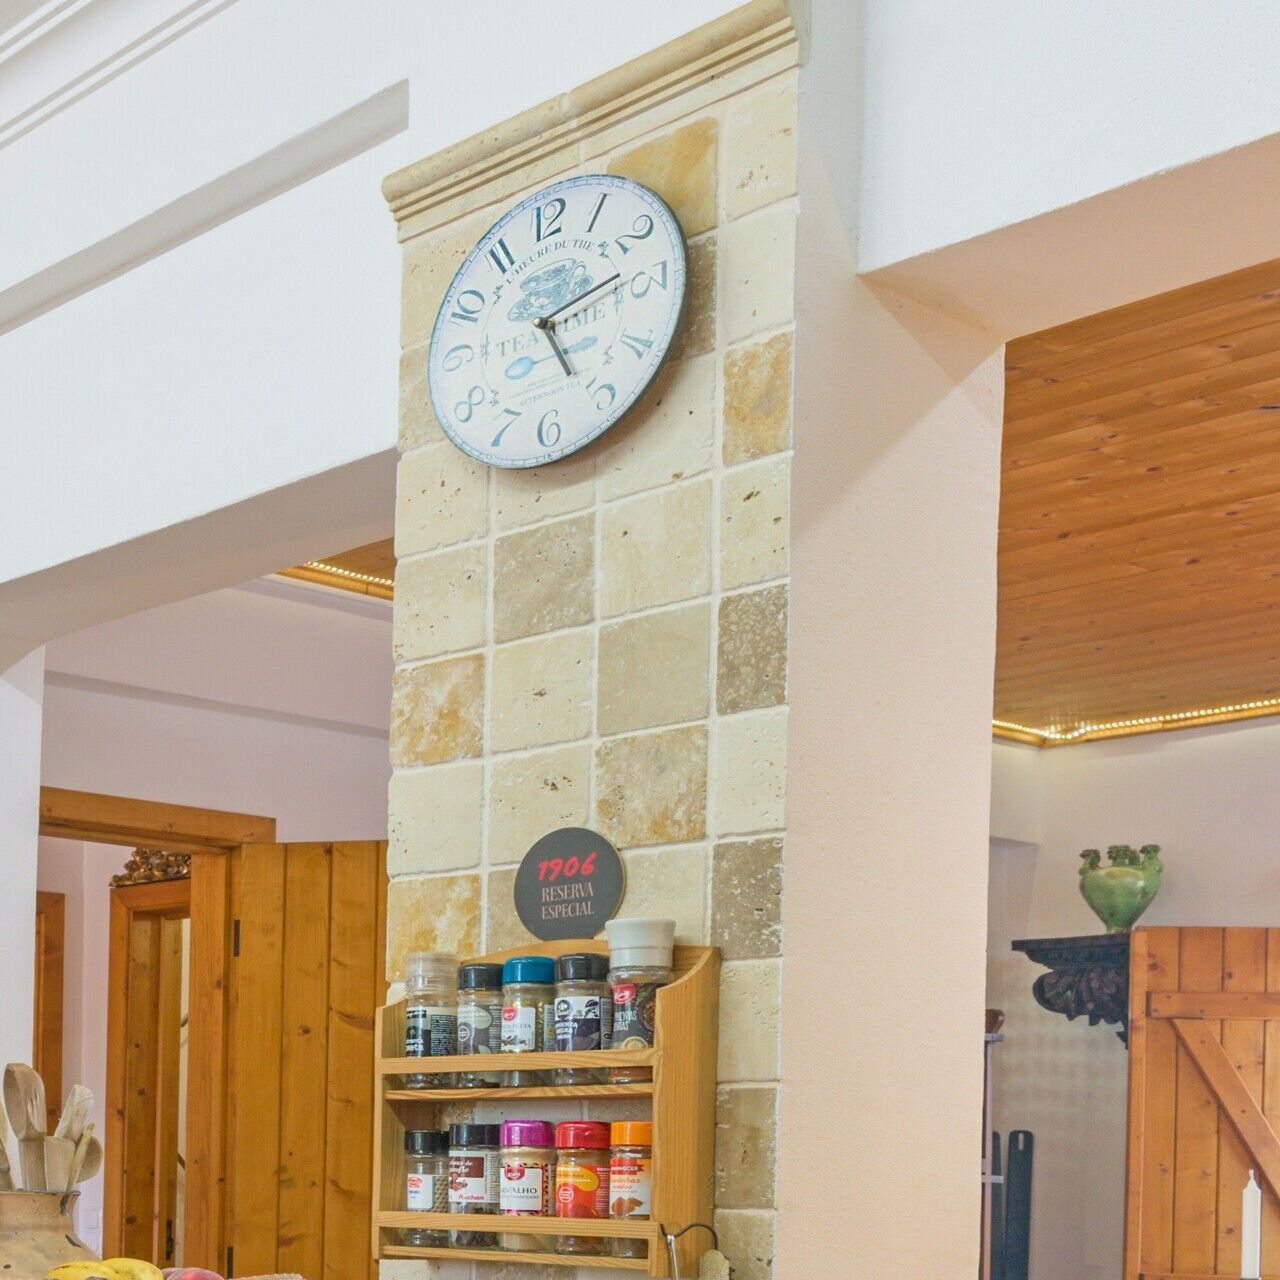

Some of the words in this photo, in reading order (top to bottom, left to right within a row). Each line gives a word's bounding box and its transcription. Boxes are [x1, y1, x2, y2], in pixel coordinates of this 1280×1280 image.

[531, 197, 566, 243] 12
[585, 192, 612, 233] 1
[554, 240, 570, 251] DU
[615, 214, 654, 255] 2
[483, 234, 516, 275] 11
[630, 260, 668, 300] 3
[449, 289, 485, 327] 10
[443, 344, 475, 373] 9
[496, 329, 540, 357] TEA
[620, 329, 657, 361] 4
[453, 385, 485, 424] 8
[585, 377, 617, 411] 5
[490, 408, 522, 447] 7
[537, 409, 561, 448] 6
[538, 851, 597, 882] 1906
[541, 901, 595, 920] ESPECIAL
[542, 881, 594, 902] RESERVA
